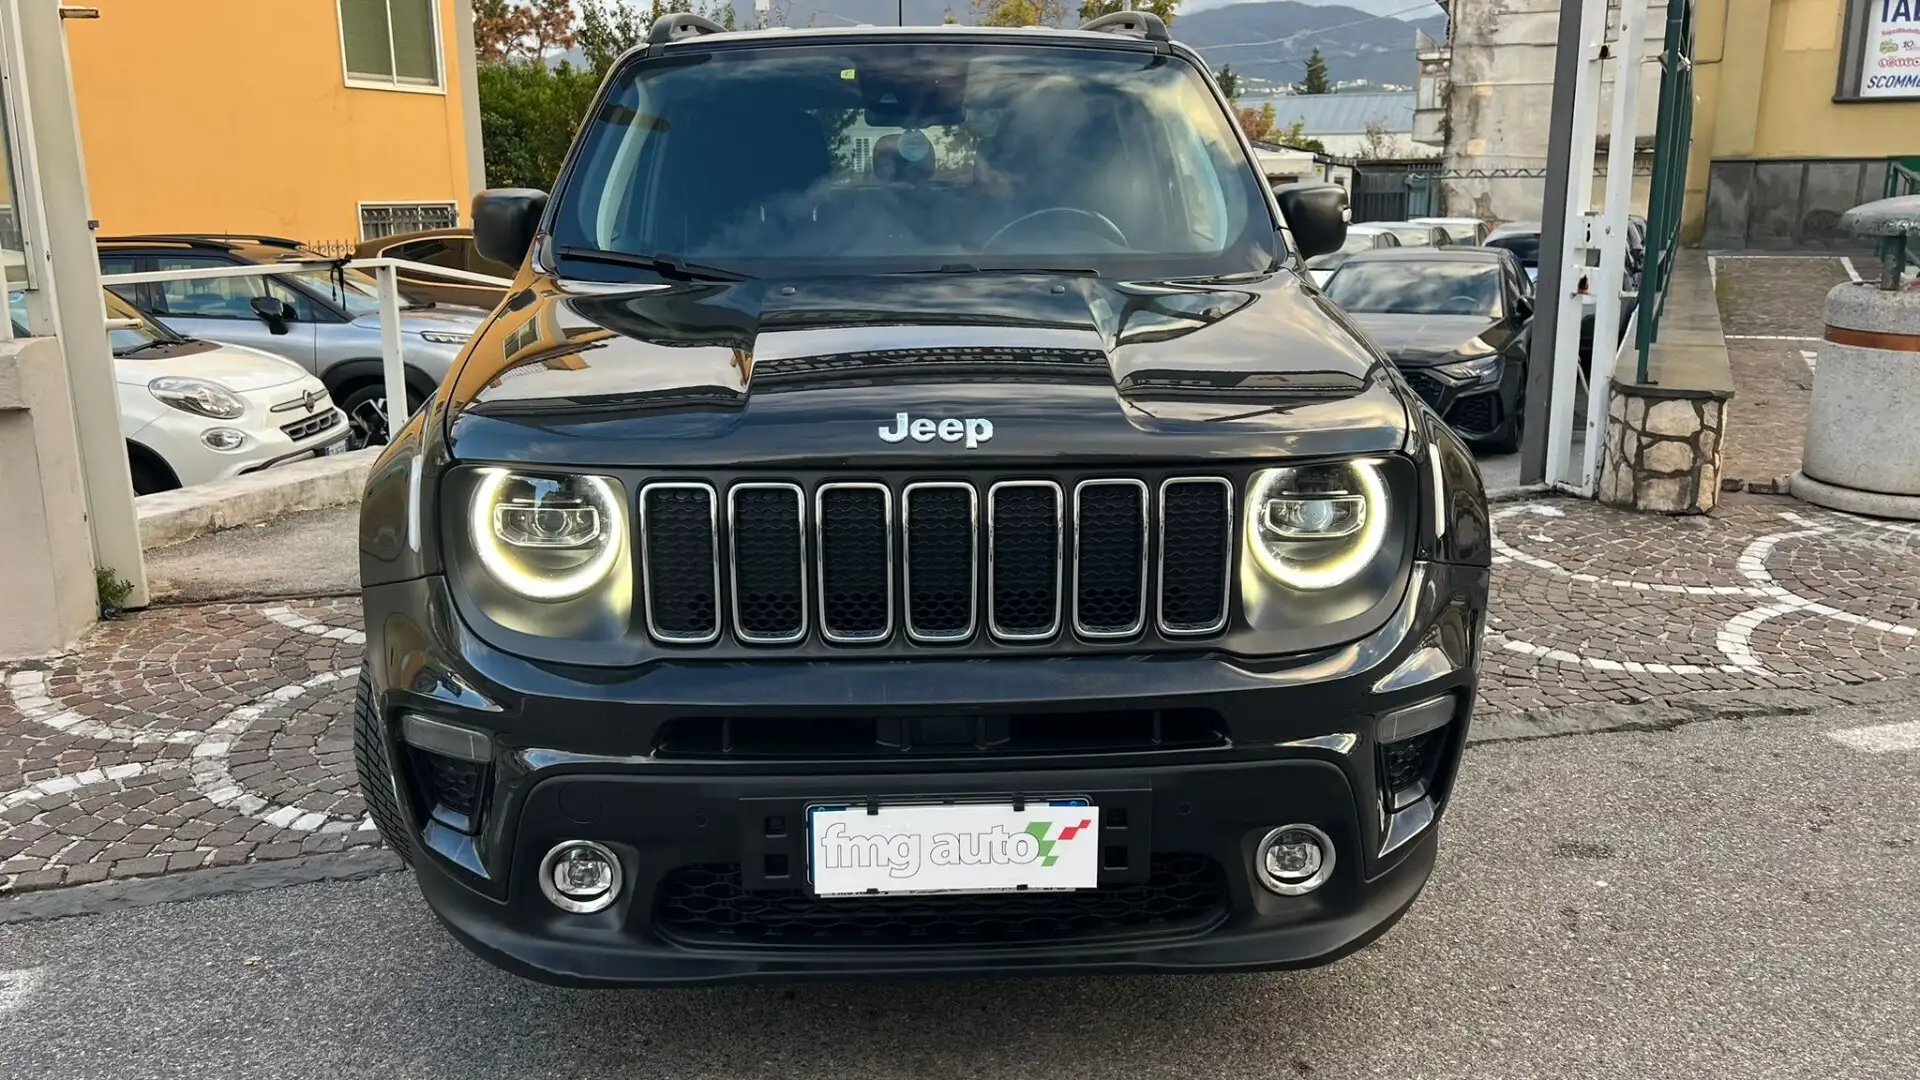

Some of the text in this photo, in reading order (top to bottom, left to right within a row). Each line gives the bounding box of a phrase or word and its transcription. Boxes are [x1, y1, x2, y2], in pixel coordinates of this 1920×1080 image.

[878, 412, 994, 449] Jeep
[821, 823, 1040, 878] fmg auto
